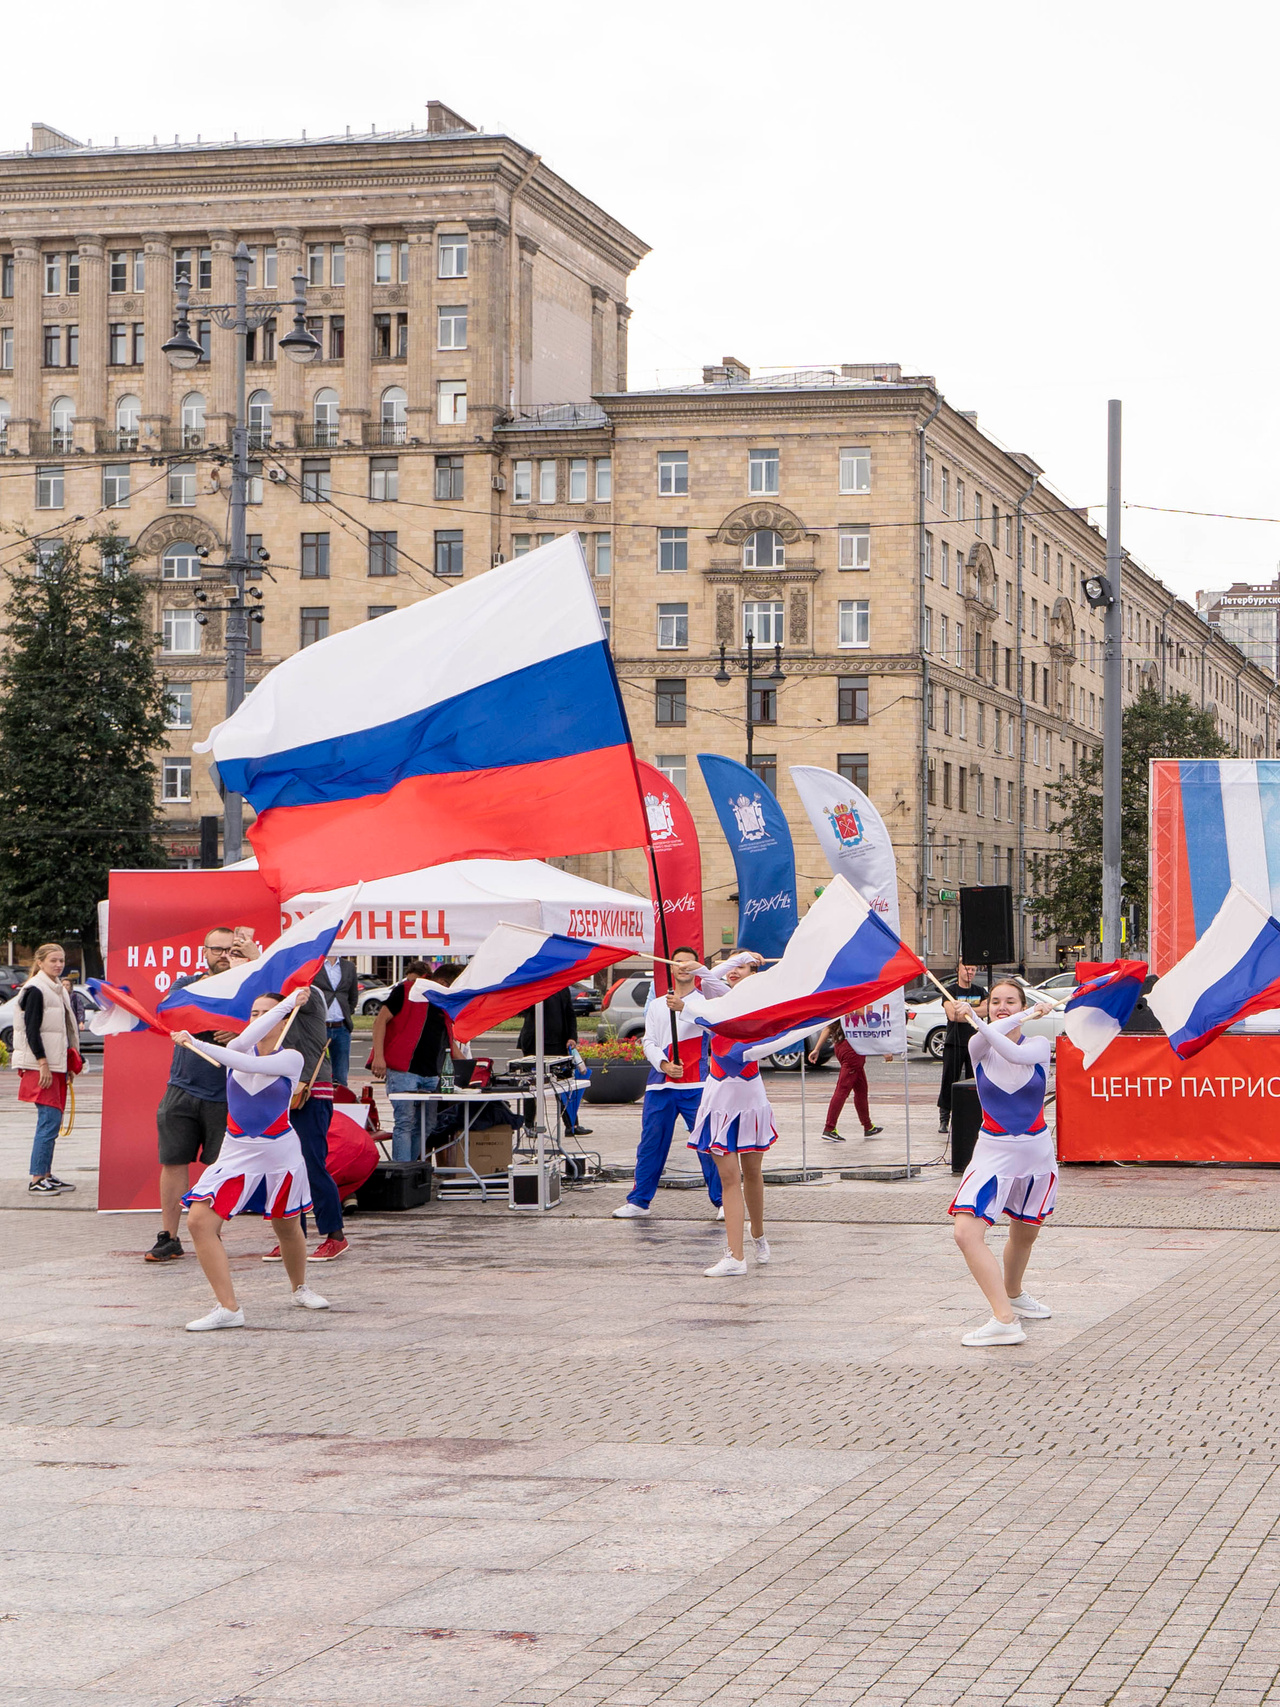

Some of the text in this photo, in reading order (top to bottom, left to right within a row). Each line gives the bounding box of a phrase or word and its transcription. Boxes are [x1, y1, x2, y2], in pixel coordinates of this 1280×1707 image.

[171, 843, 200, 856] Бан
[567, 909, 645, 943] ДЗЕРЖИНЕЦ
[127, 941, 263, 969] НАРОД
[845, 1030, 891, 1038] ПЕТЕРБУРГ
[1090, 1077, 1172, 1101] ЦЕНТР
